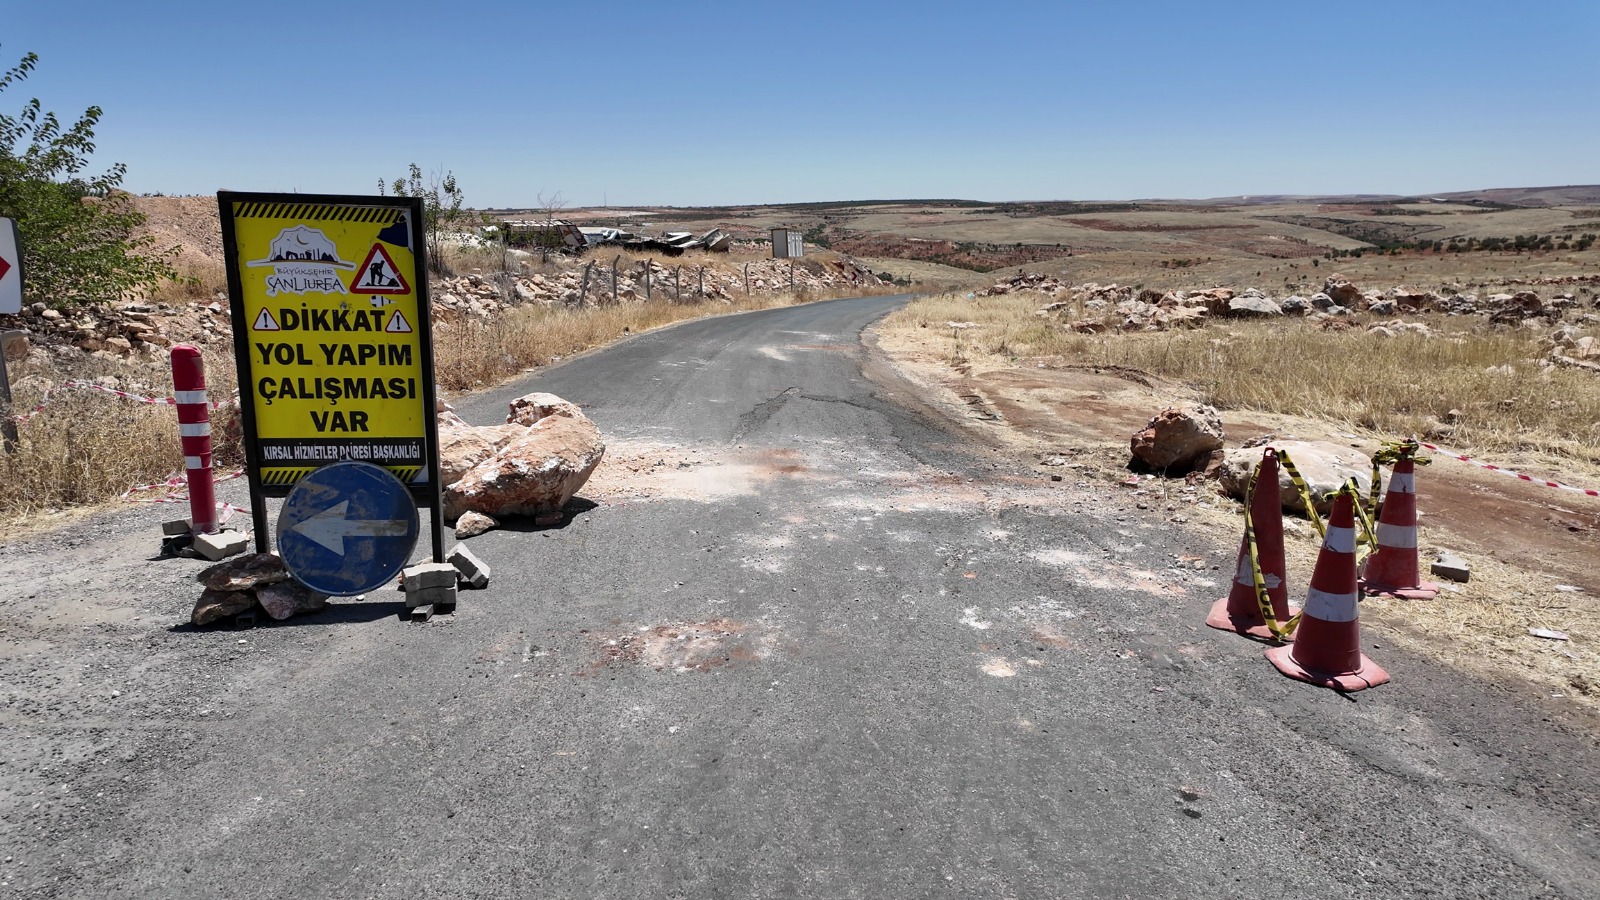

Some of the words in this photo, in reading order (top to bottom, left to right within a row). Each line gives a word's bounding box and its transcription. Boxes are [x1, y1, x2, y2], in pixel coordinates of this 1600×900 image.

[279, 302, 386, 332] DİKKAT
[255, 343, 313, 366] YOL
[318, 343, 413, 366] YAPIM
[258, 376, 416, 406] ÇALIŞMASI
[309, 410, 370, 433] VAR
[263, 445, 294, 460] KIRSAL
[294, 442, 338, 460] HİZMETLER
[372, 441, 421, 463] BAŞKANLIĞI
